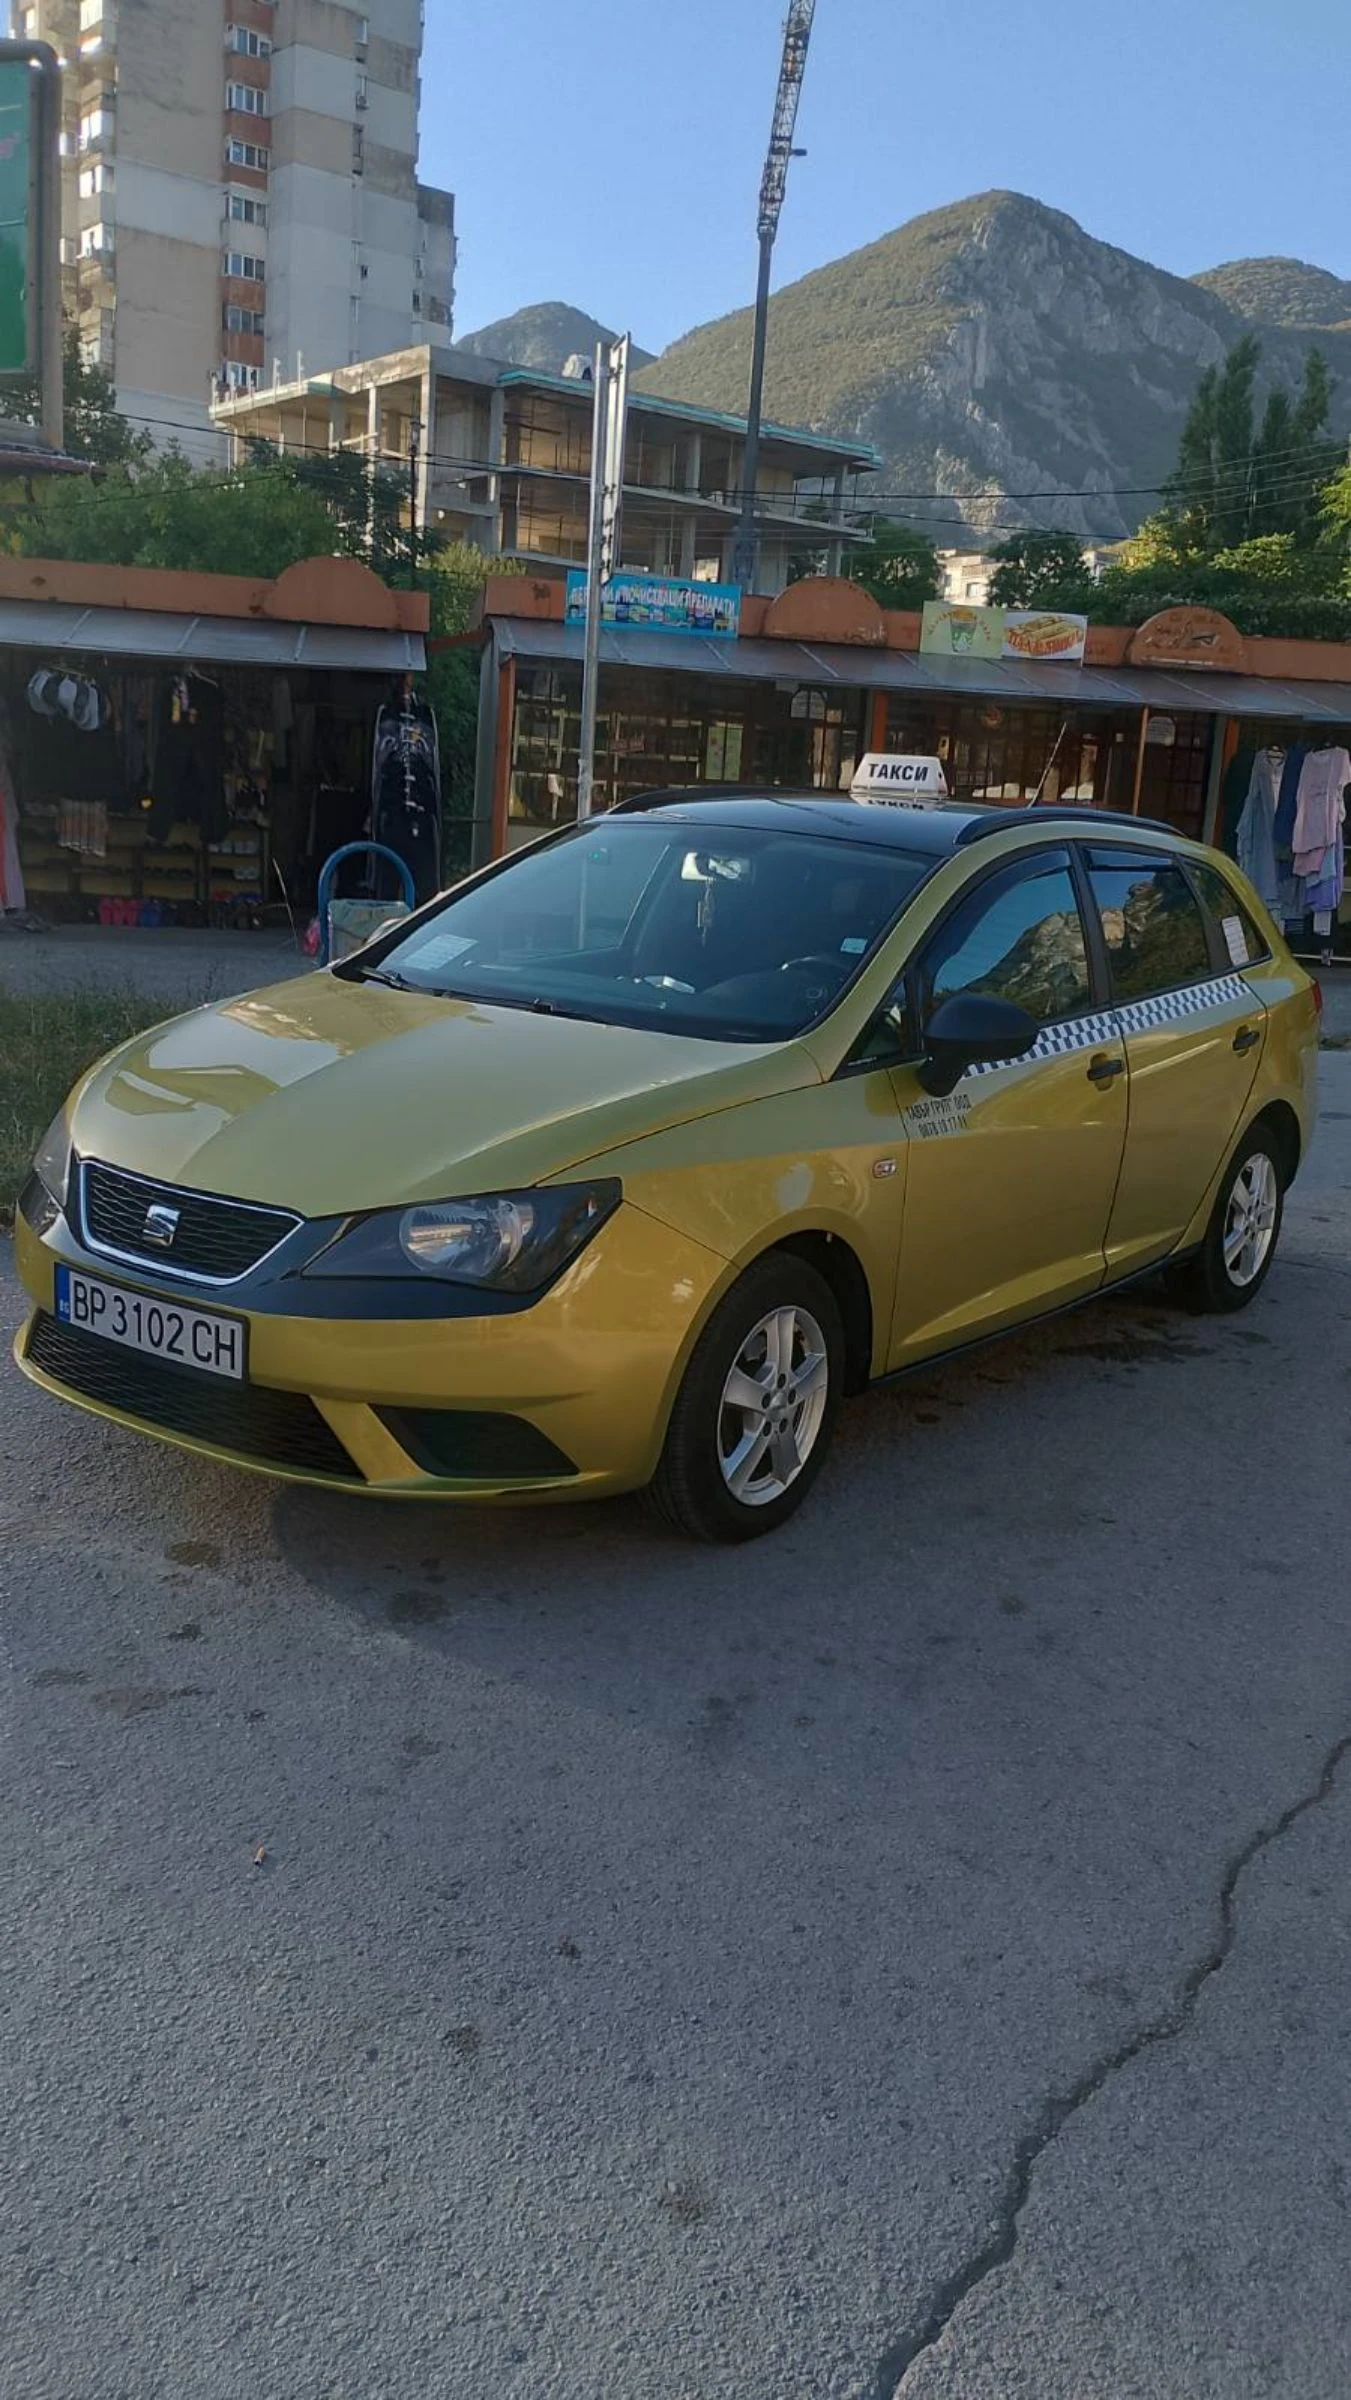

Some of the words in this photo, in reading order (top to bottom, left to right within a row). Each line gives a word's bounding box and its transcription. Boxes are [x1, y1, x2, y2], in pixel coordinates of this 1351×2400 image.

[685, 588, 735, 616] ПРЕПАРАТИ
[868, 763, 929, 781] ТАКСИ
[112, 1294, 185, 1356] 3102
